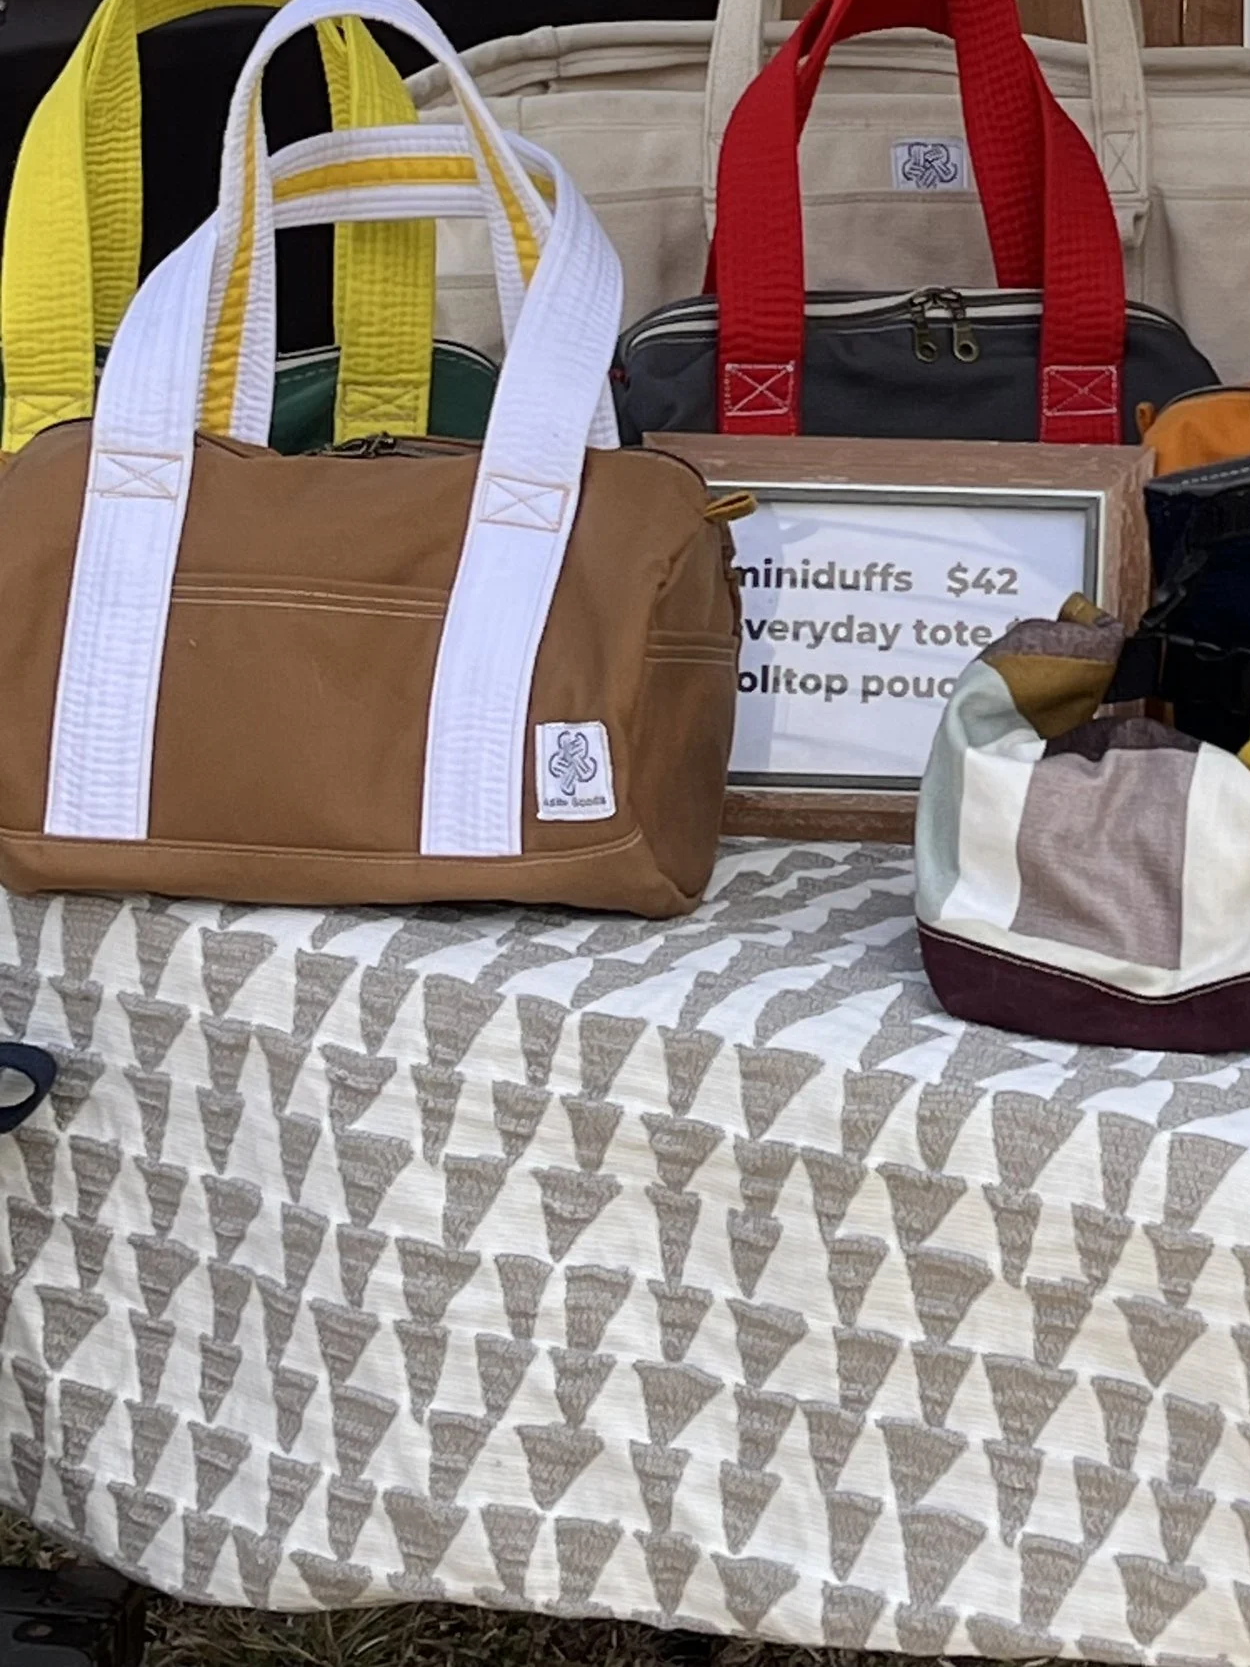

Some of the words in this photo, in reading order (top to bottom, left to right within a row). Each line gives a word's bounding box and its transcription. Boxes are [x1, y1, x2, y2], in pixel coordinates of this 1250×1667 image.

[734, 557, 913, 592] miniduffs
[946, 561, 1018, 598] $42
[743, 614, 902, 652] veryday
[913, 619, 993, 647] tote
[737, 665, 849, 703] olltop
[860, 674, 959, 704] pouc
